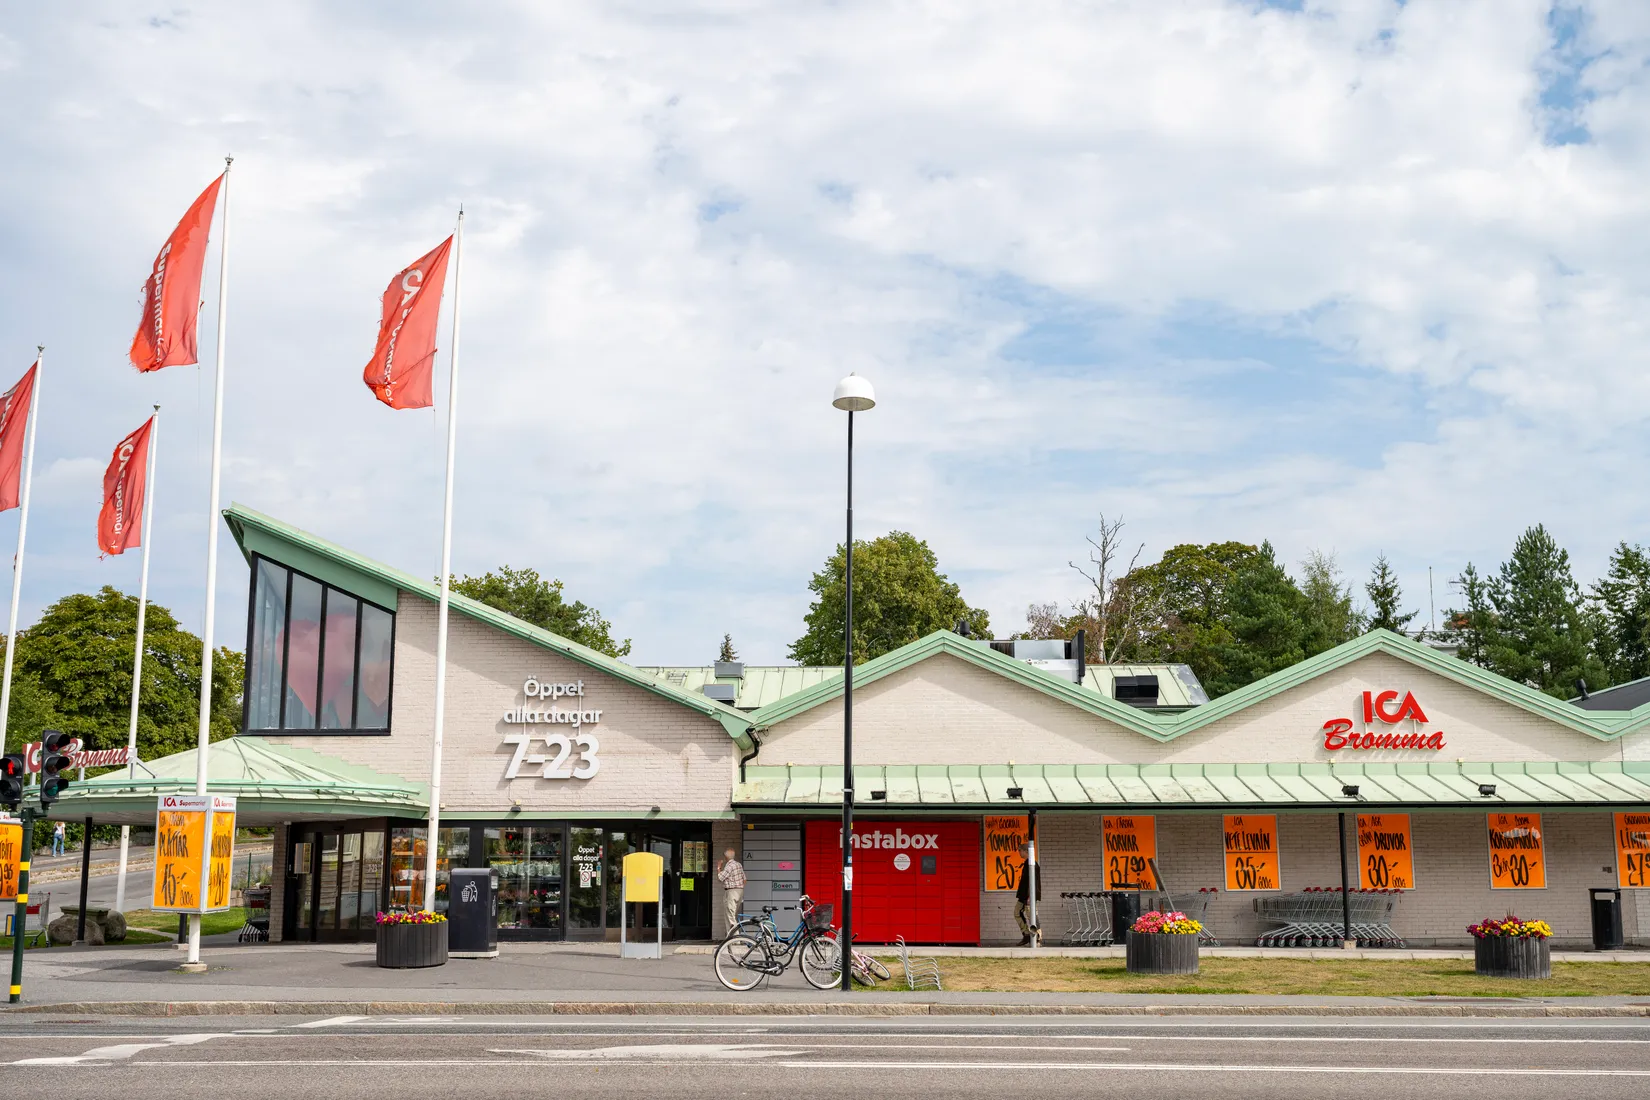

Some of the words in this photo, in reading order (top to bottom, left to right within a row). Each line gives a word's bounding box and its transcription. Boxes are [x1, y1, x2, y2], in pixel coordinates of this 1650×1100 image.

[524, 675, 584, 700] Öppet
[503, 705, 540, 723] alla
[543, 705, 603, 728] dagar
[1362, 690, 1429, 724] ICA
[1322, 718, 1448, 750] Bromma
[503, 733, 600, 779] 7-23
[163, 797, 177, 807] ICA
[839, 828, 939, 849] instabox
[1105, 832, 1139, 852] KORVAR
[1373, 831, 1407, 851] DRUVOR
